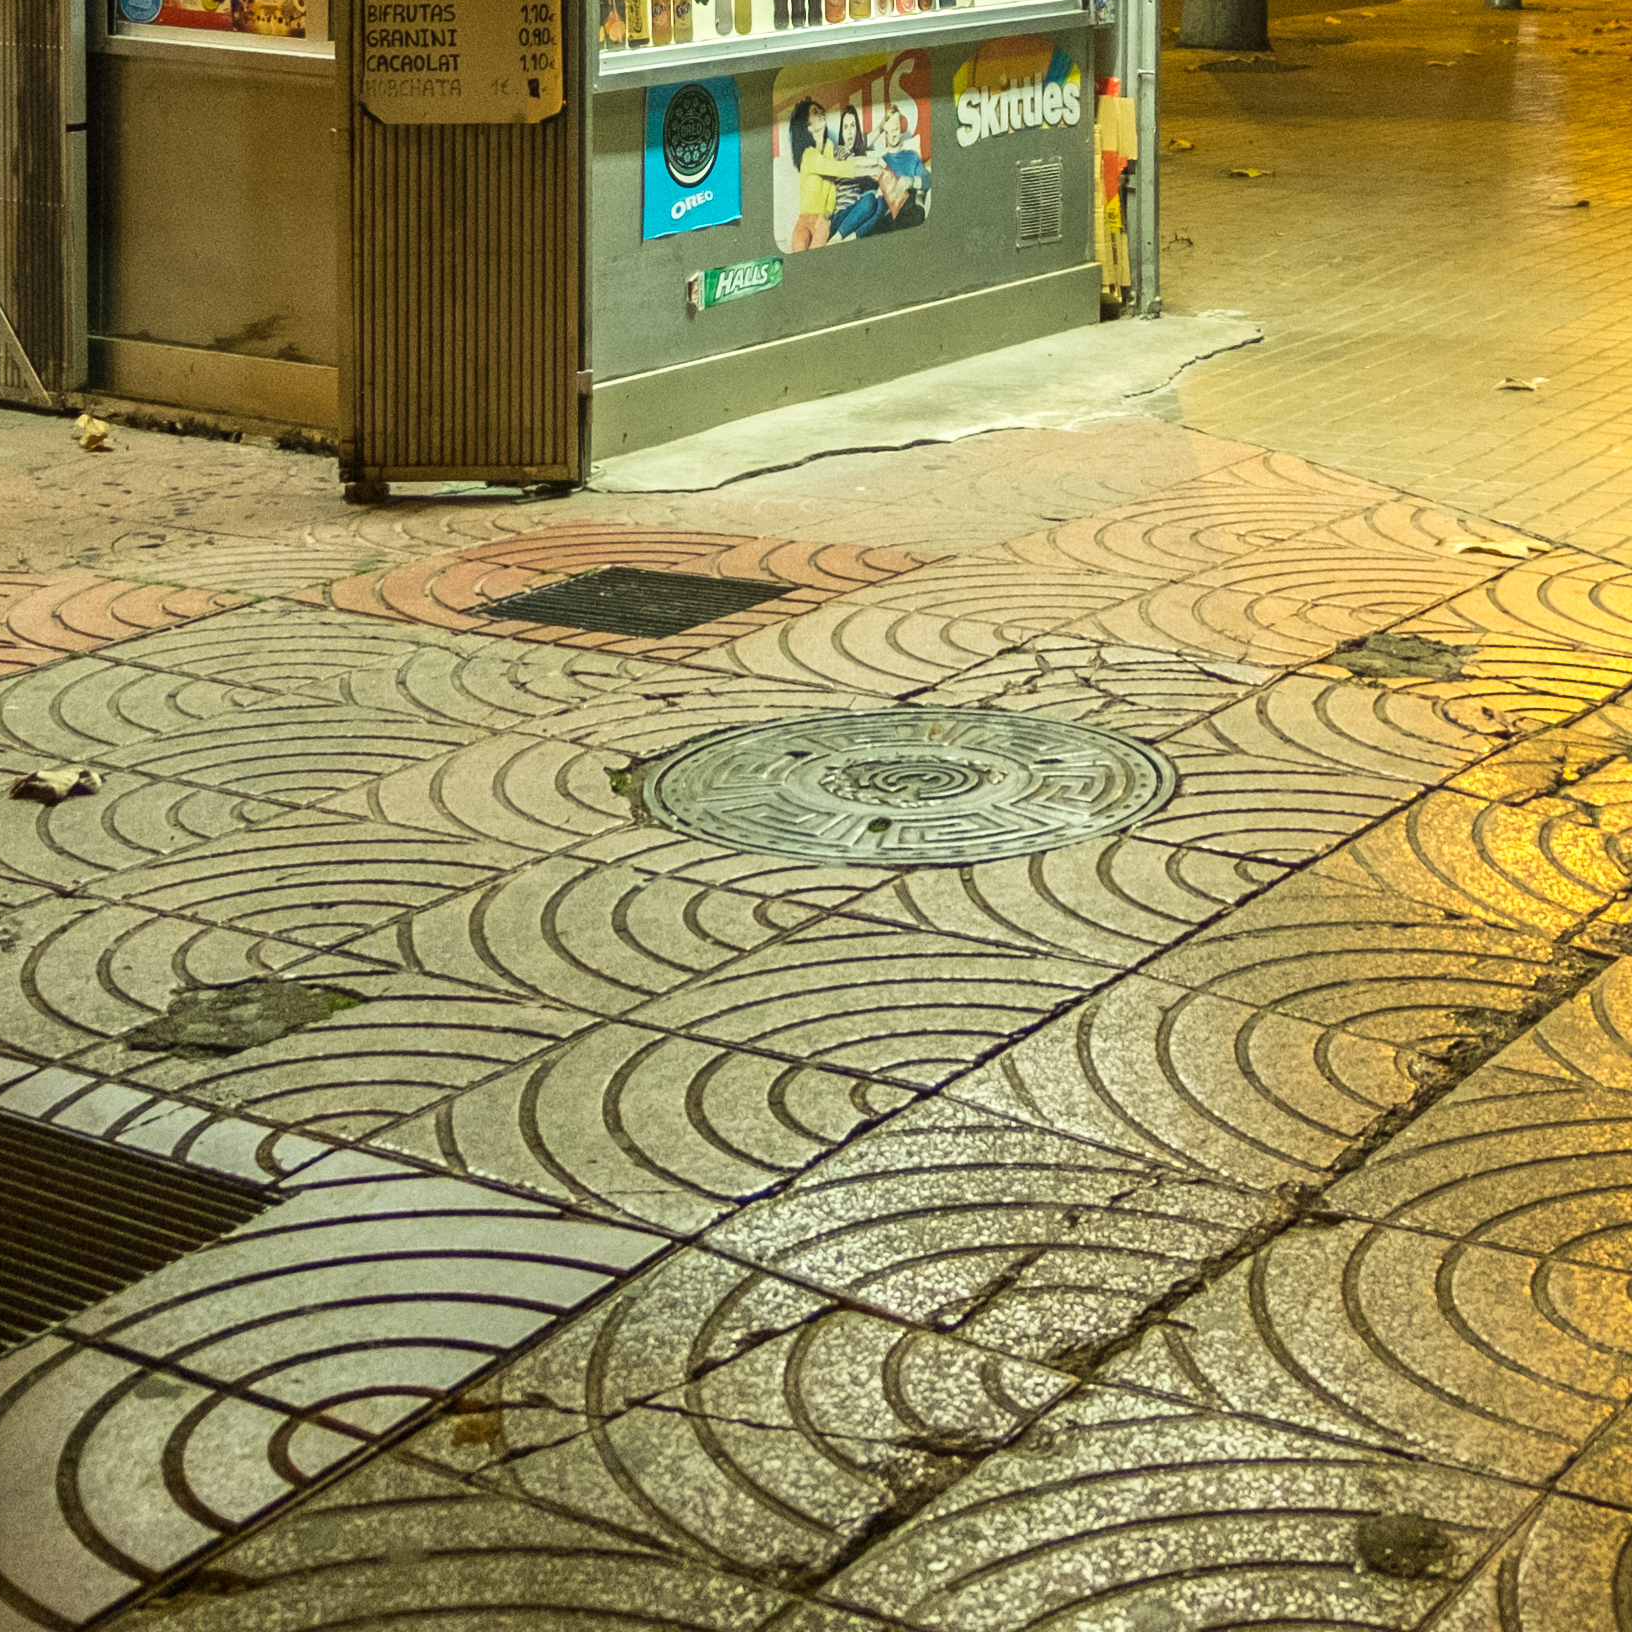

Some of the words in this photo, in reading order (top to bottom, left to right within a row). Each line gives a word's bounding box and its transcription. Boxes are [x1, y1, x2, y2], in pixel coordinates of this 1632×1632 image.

[366, 4, 456, 23] BIFRUTAS
[367, 29, 457, 48] GRANINI
[367, 54, 460, 72] CACAOLAT
[956, 71, 1081, 148] Skittles
[670, 190, 714, 220] OREO
[715, 263, 770, 300] HALLS
